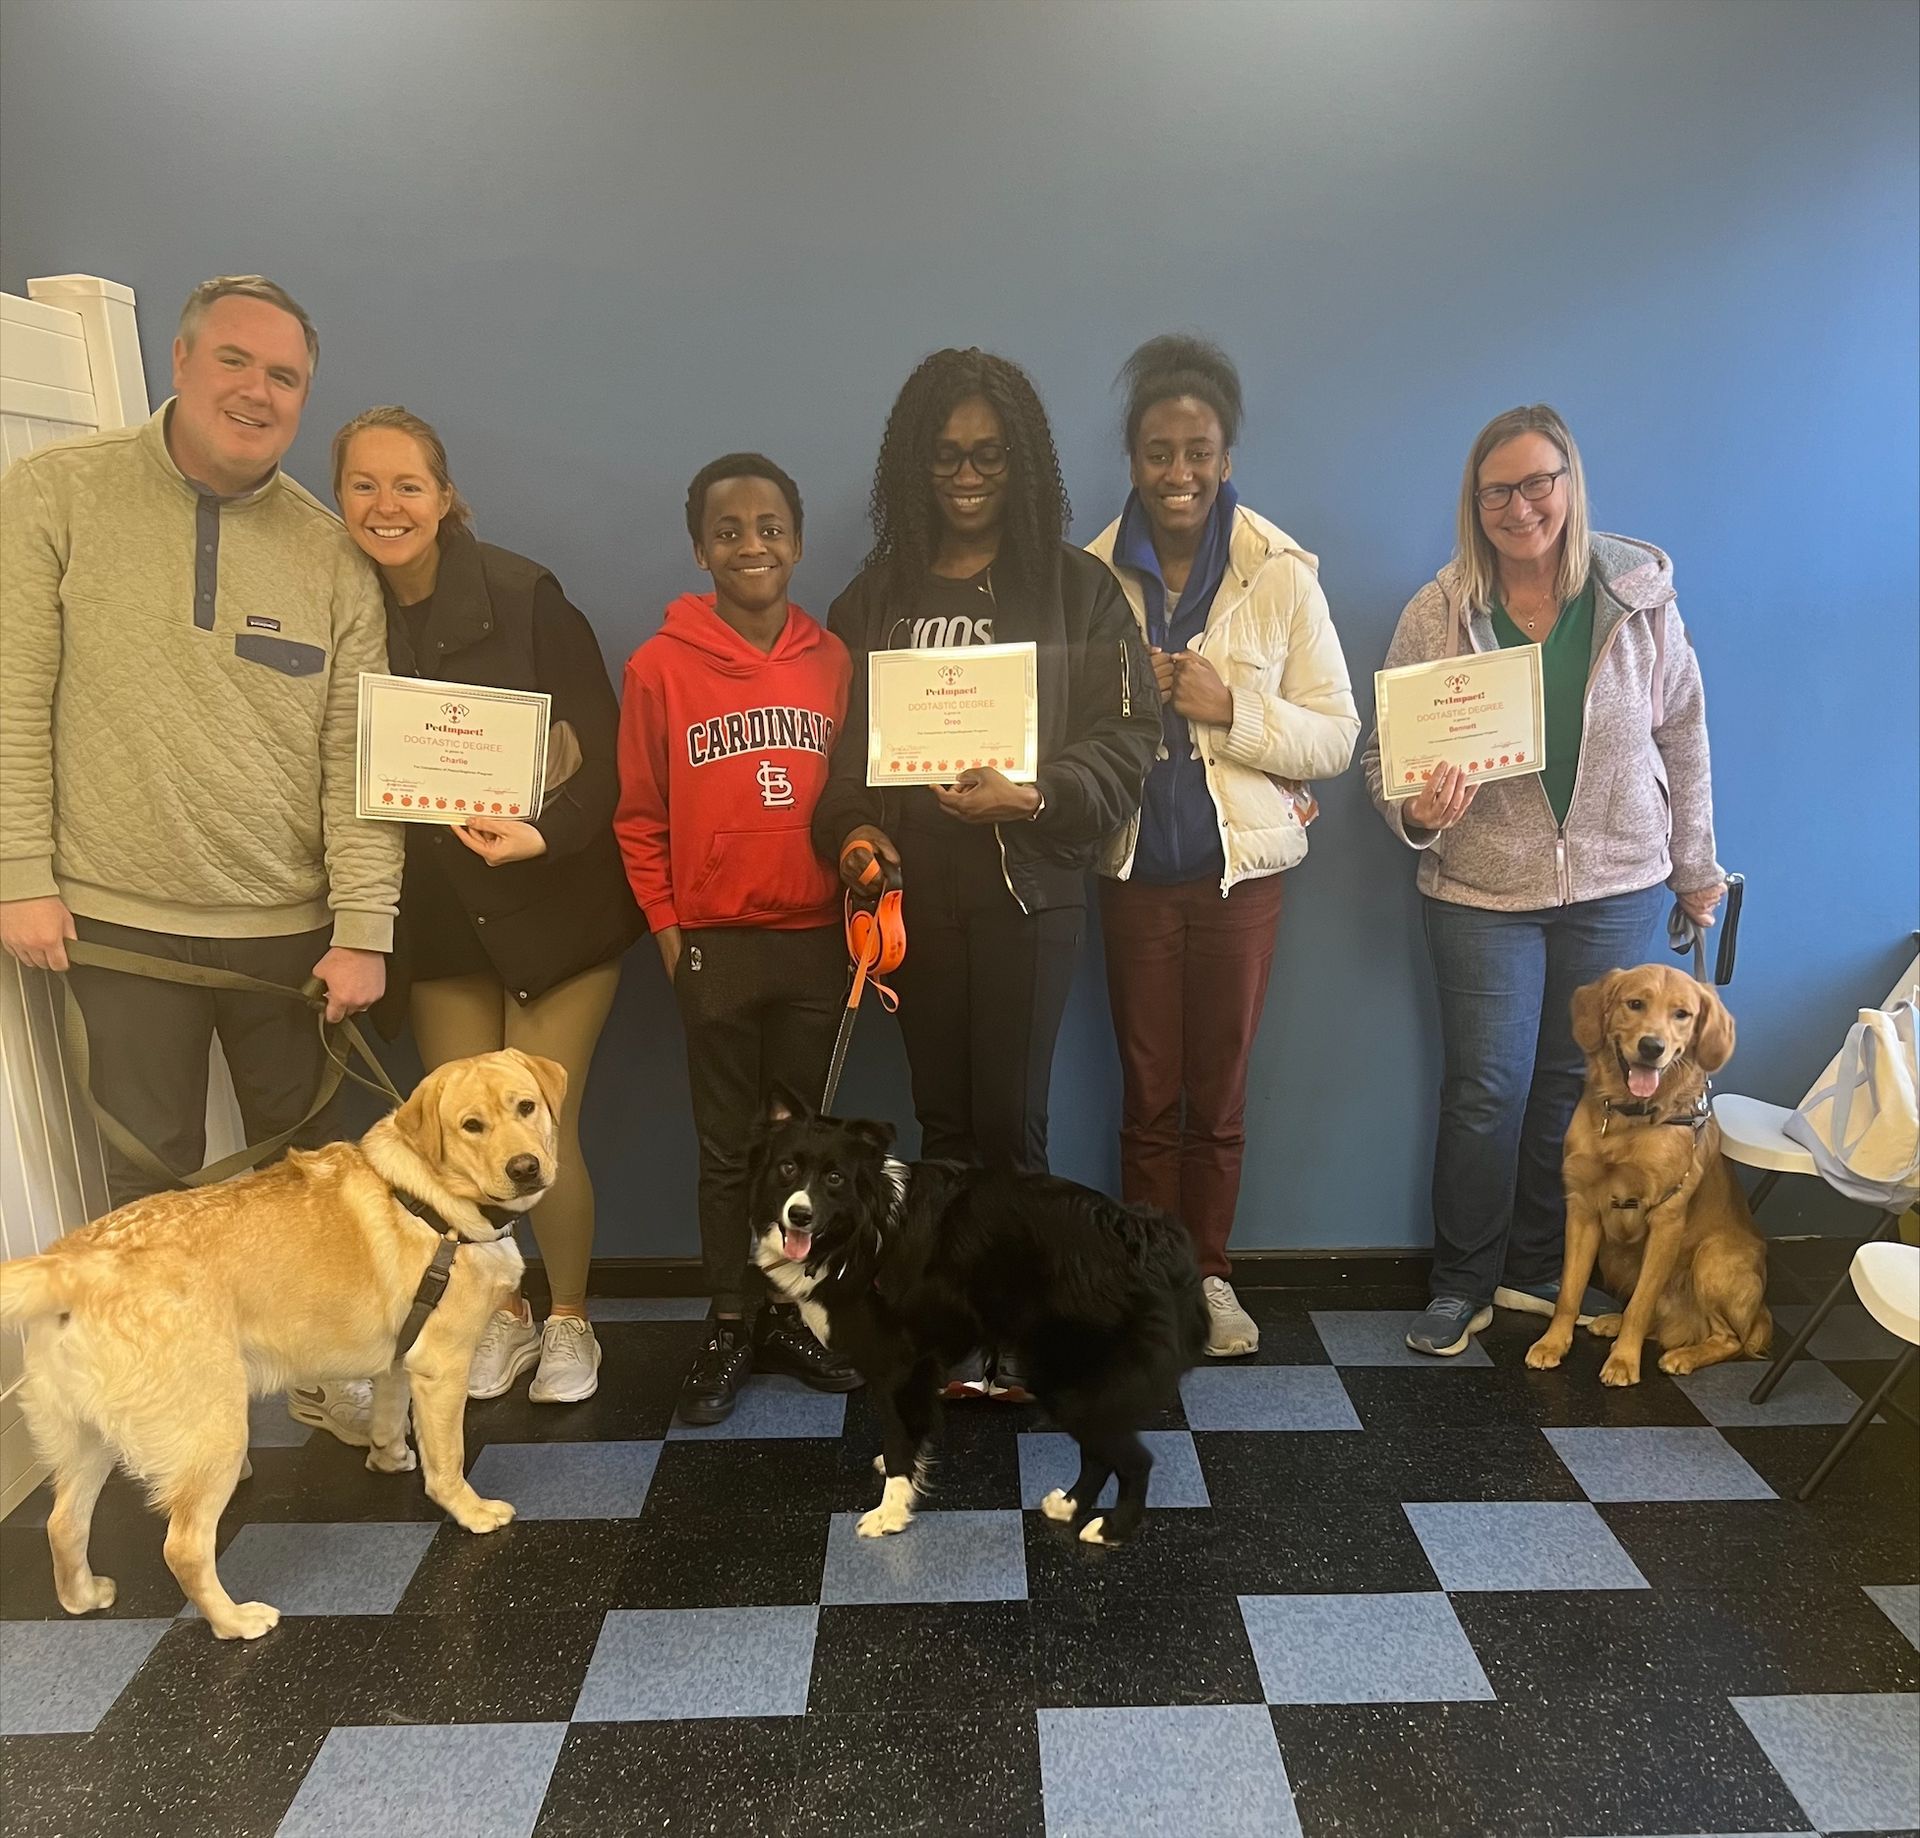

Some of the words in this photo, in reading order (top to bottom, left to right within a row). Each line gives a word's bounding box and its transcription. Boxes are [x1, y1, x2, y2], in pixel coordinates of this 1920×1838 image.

[926, 686, 977, 697] PetImpact!
[1433, 691, 1485, 706] PetImpact!
[908, 701, 957, 711] DOGTASTIC
[959, 699, 995, 709] DEGREE
[1416, 708, 1466, 722] DOGTASTIC
[1468, 702, 1505, 715] DEGREE
[425, 723, 484, 736] PetImpact!
[1449, 723, 1477, 733] Bennett
[404, 735, 460, 748] DOGTASTIC
[462, 741, 503, 753] DEGREE
[440, 755, 468, 765] Charlie
